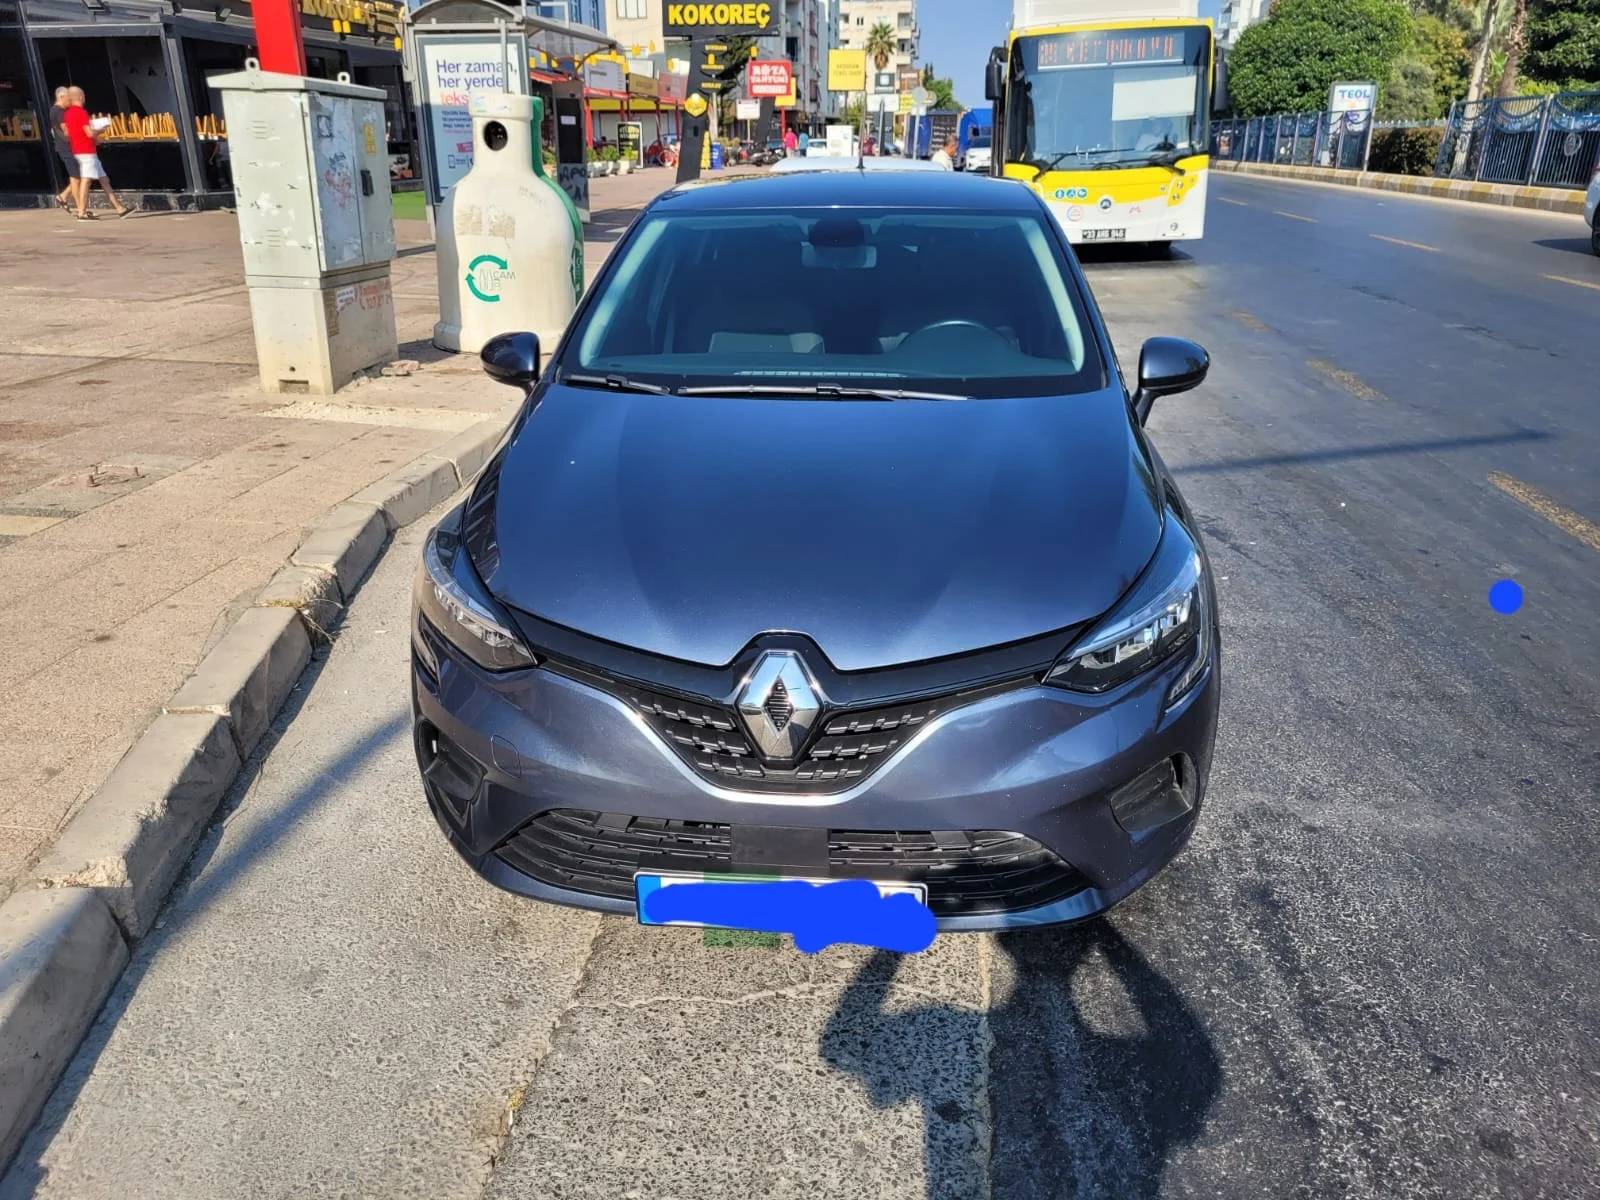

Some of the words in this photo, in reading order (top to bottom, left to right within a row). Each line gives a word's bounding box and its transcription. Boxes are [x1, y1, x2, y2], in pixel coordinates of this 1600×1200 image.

[668, 3, 772, 29] KOKOREÇ
[436, 59, 461, 74] Her
[437, 75, 461, 88] her
[465, 75, 504, 92] yerde
